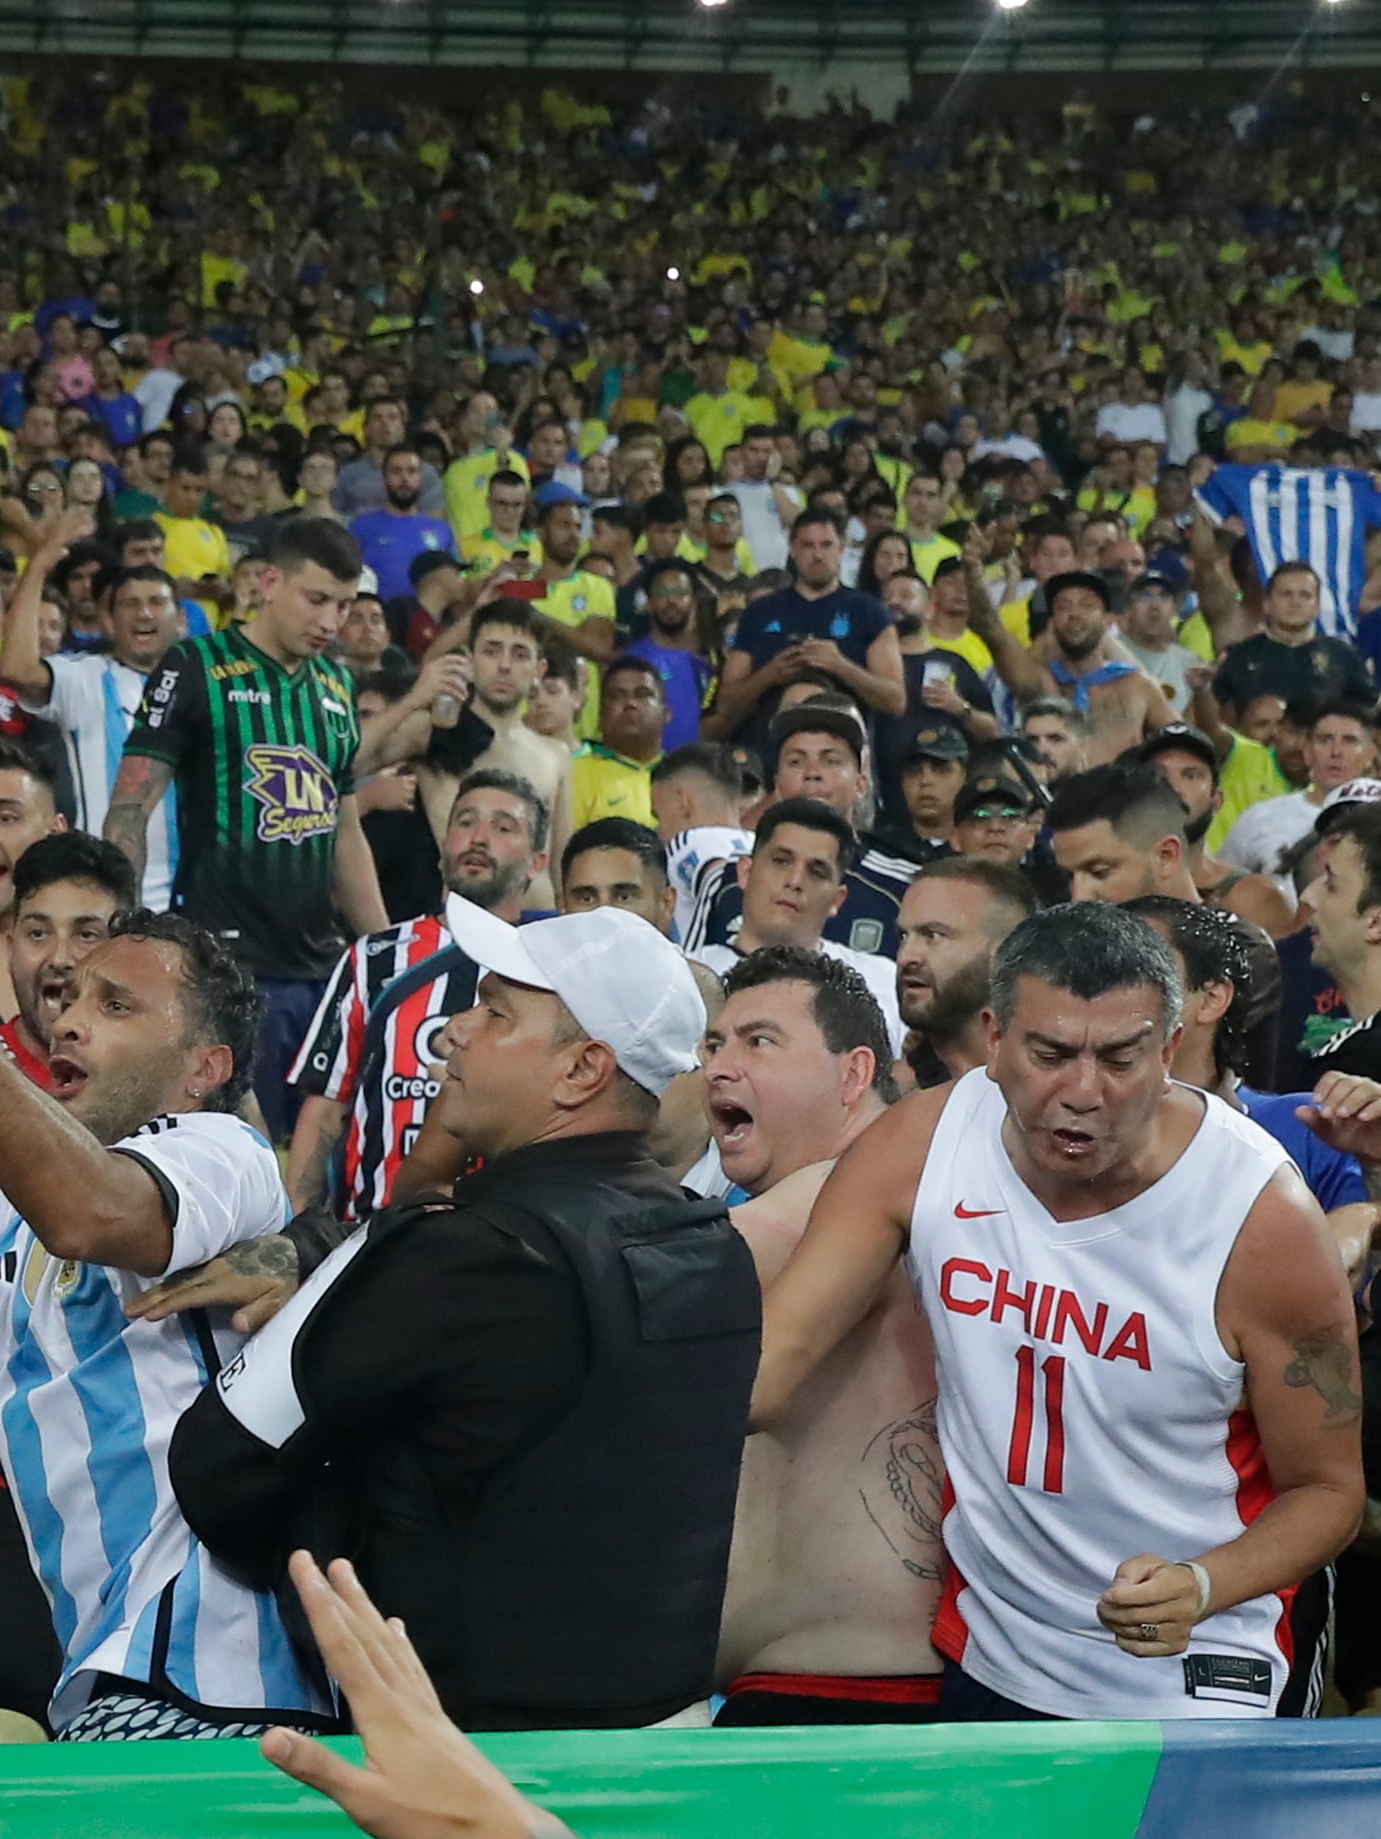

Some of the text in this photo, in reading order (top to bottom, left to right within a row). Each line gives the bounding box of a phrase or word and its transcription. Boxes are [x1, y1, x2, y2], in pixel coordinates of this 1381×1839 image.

[228, 688, 271, 705] mitre
[282, 768, 324, 812] LN
[939, 1256, 1152, 1372] CHINA
[1007, 1344, 1066, 1494] 11
